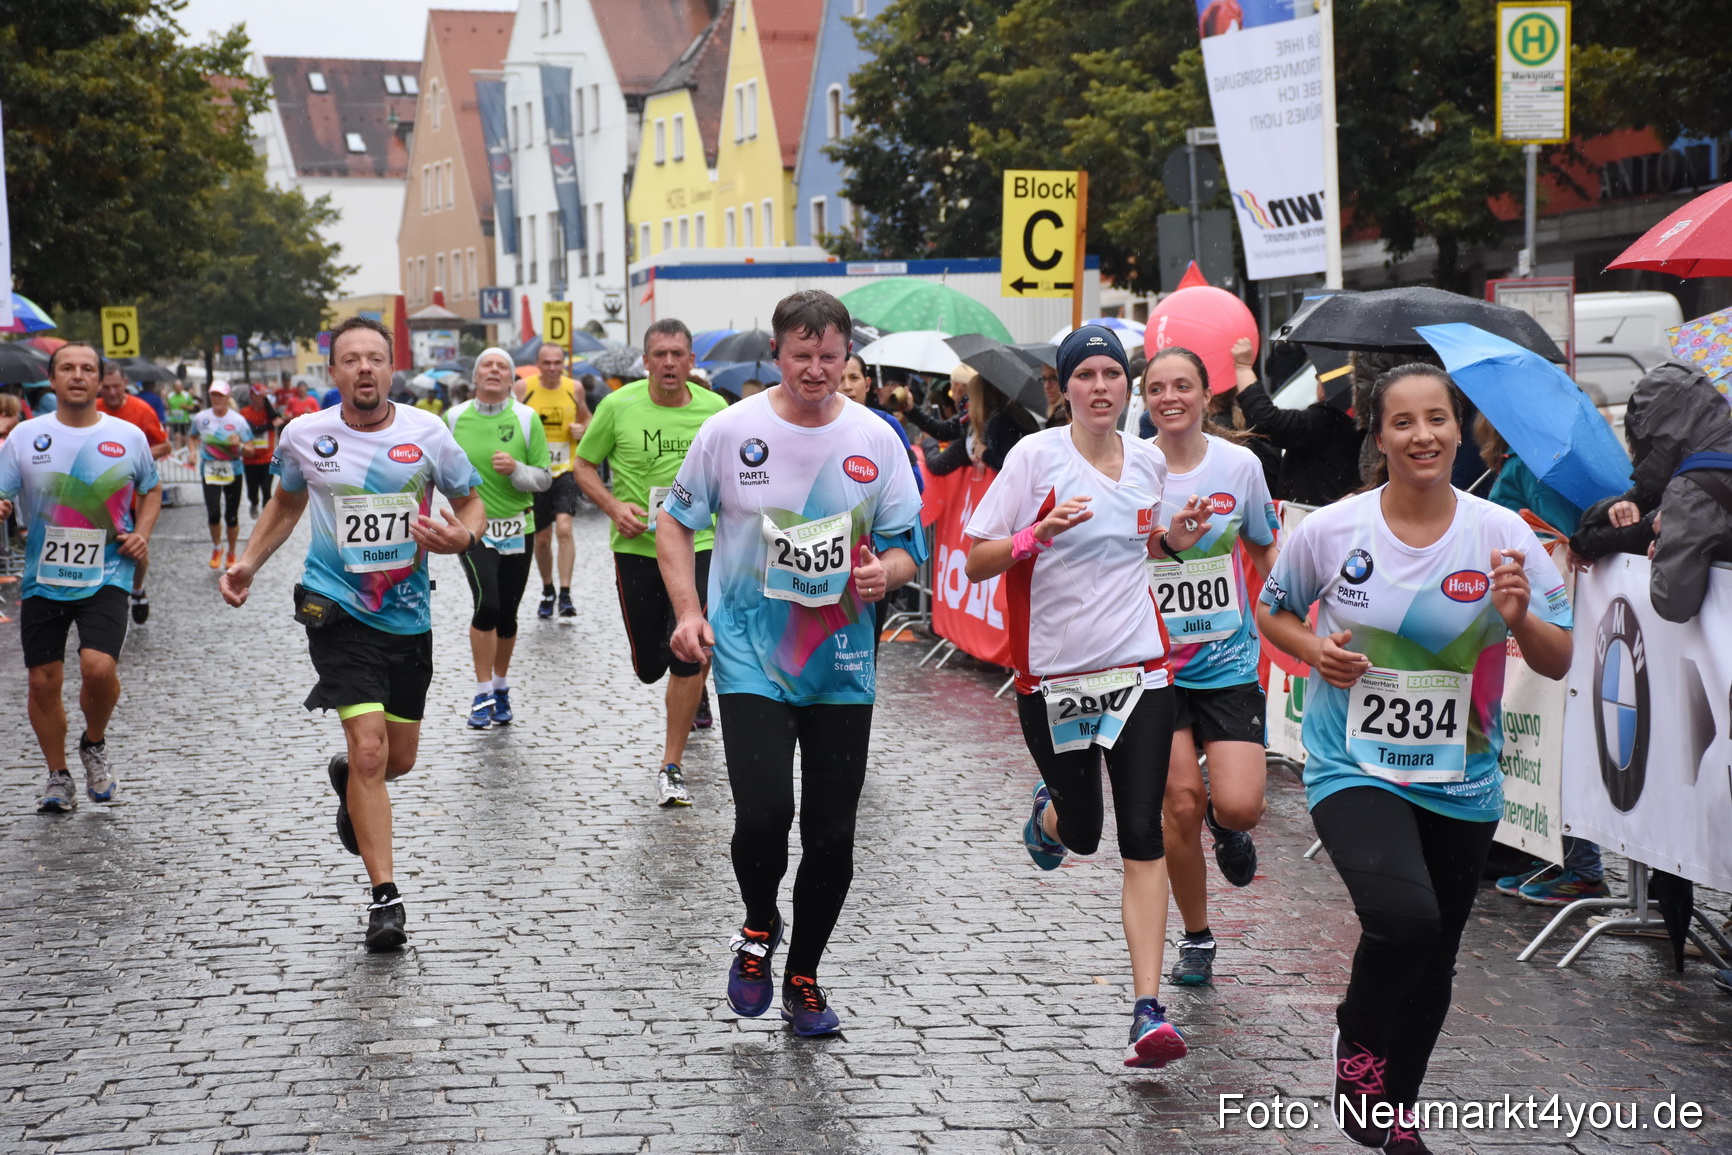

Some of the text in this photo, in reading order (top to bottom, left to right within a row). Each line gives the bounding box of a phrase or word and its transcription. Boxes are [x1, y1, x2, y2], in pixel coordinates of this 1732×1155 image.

[1014, 176, 1077, 199] Block
[1022, 209, 1064, 271] C
[111, 322, 130, 346] D
[551, 316, 565, 339] D
[392, 449, 419, 460] Hervis
[314, 460, 341, 468] PARTL
[848, 460, 875, 477] Hervis
[739, 471, 770, 480] PARTL
[345, 511, 411, 543] 2871
[797, 517, 846, 540] BOCK
[45, 541, 100, 565] 2127
[363, 549, 399, 562] Robert
[774, 536, 846, 573] 2555
[58, 568, 83, 580] Siega
[1186, 558, 1227, 574] BOCK
[792, 577, 829, 595] Roland
[1157, 576, 1230, 614] 2080
[1338, 586, 1370, 601] PARTL
[1448, 578, 1486, 594] Hervis
[1337, 595, 1369, 609] Neumarkt
[1182, 619, 1212, 633] Julia
[1596, 602, 1646, 675] BMW
[1086, 671, 1137, 687] BOCK
[1361, 674, 1461, 689] NeuerMarkt BOCK
[1360, 694, 1458, 740] 2334
[1377, 747, 1435, 766] Tamara
[1443, 773, 1495, 793] Neumarkter
